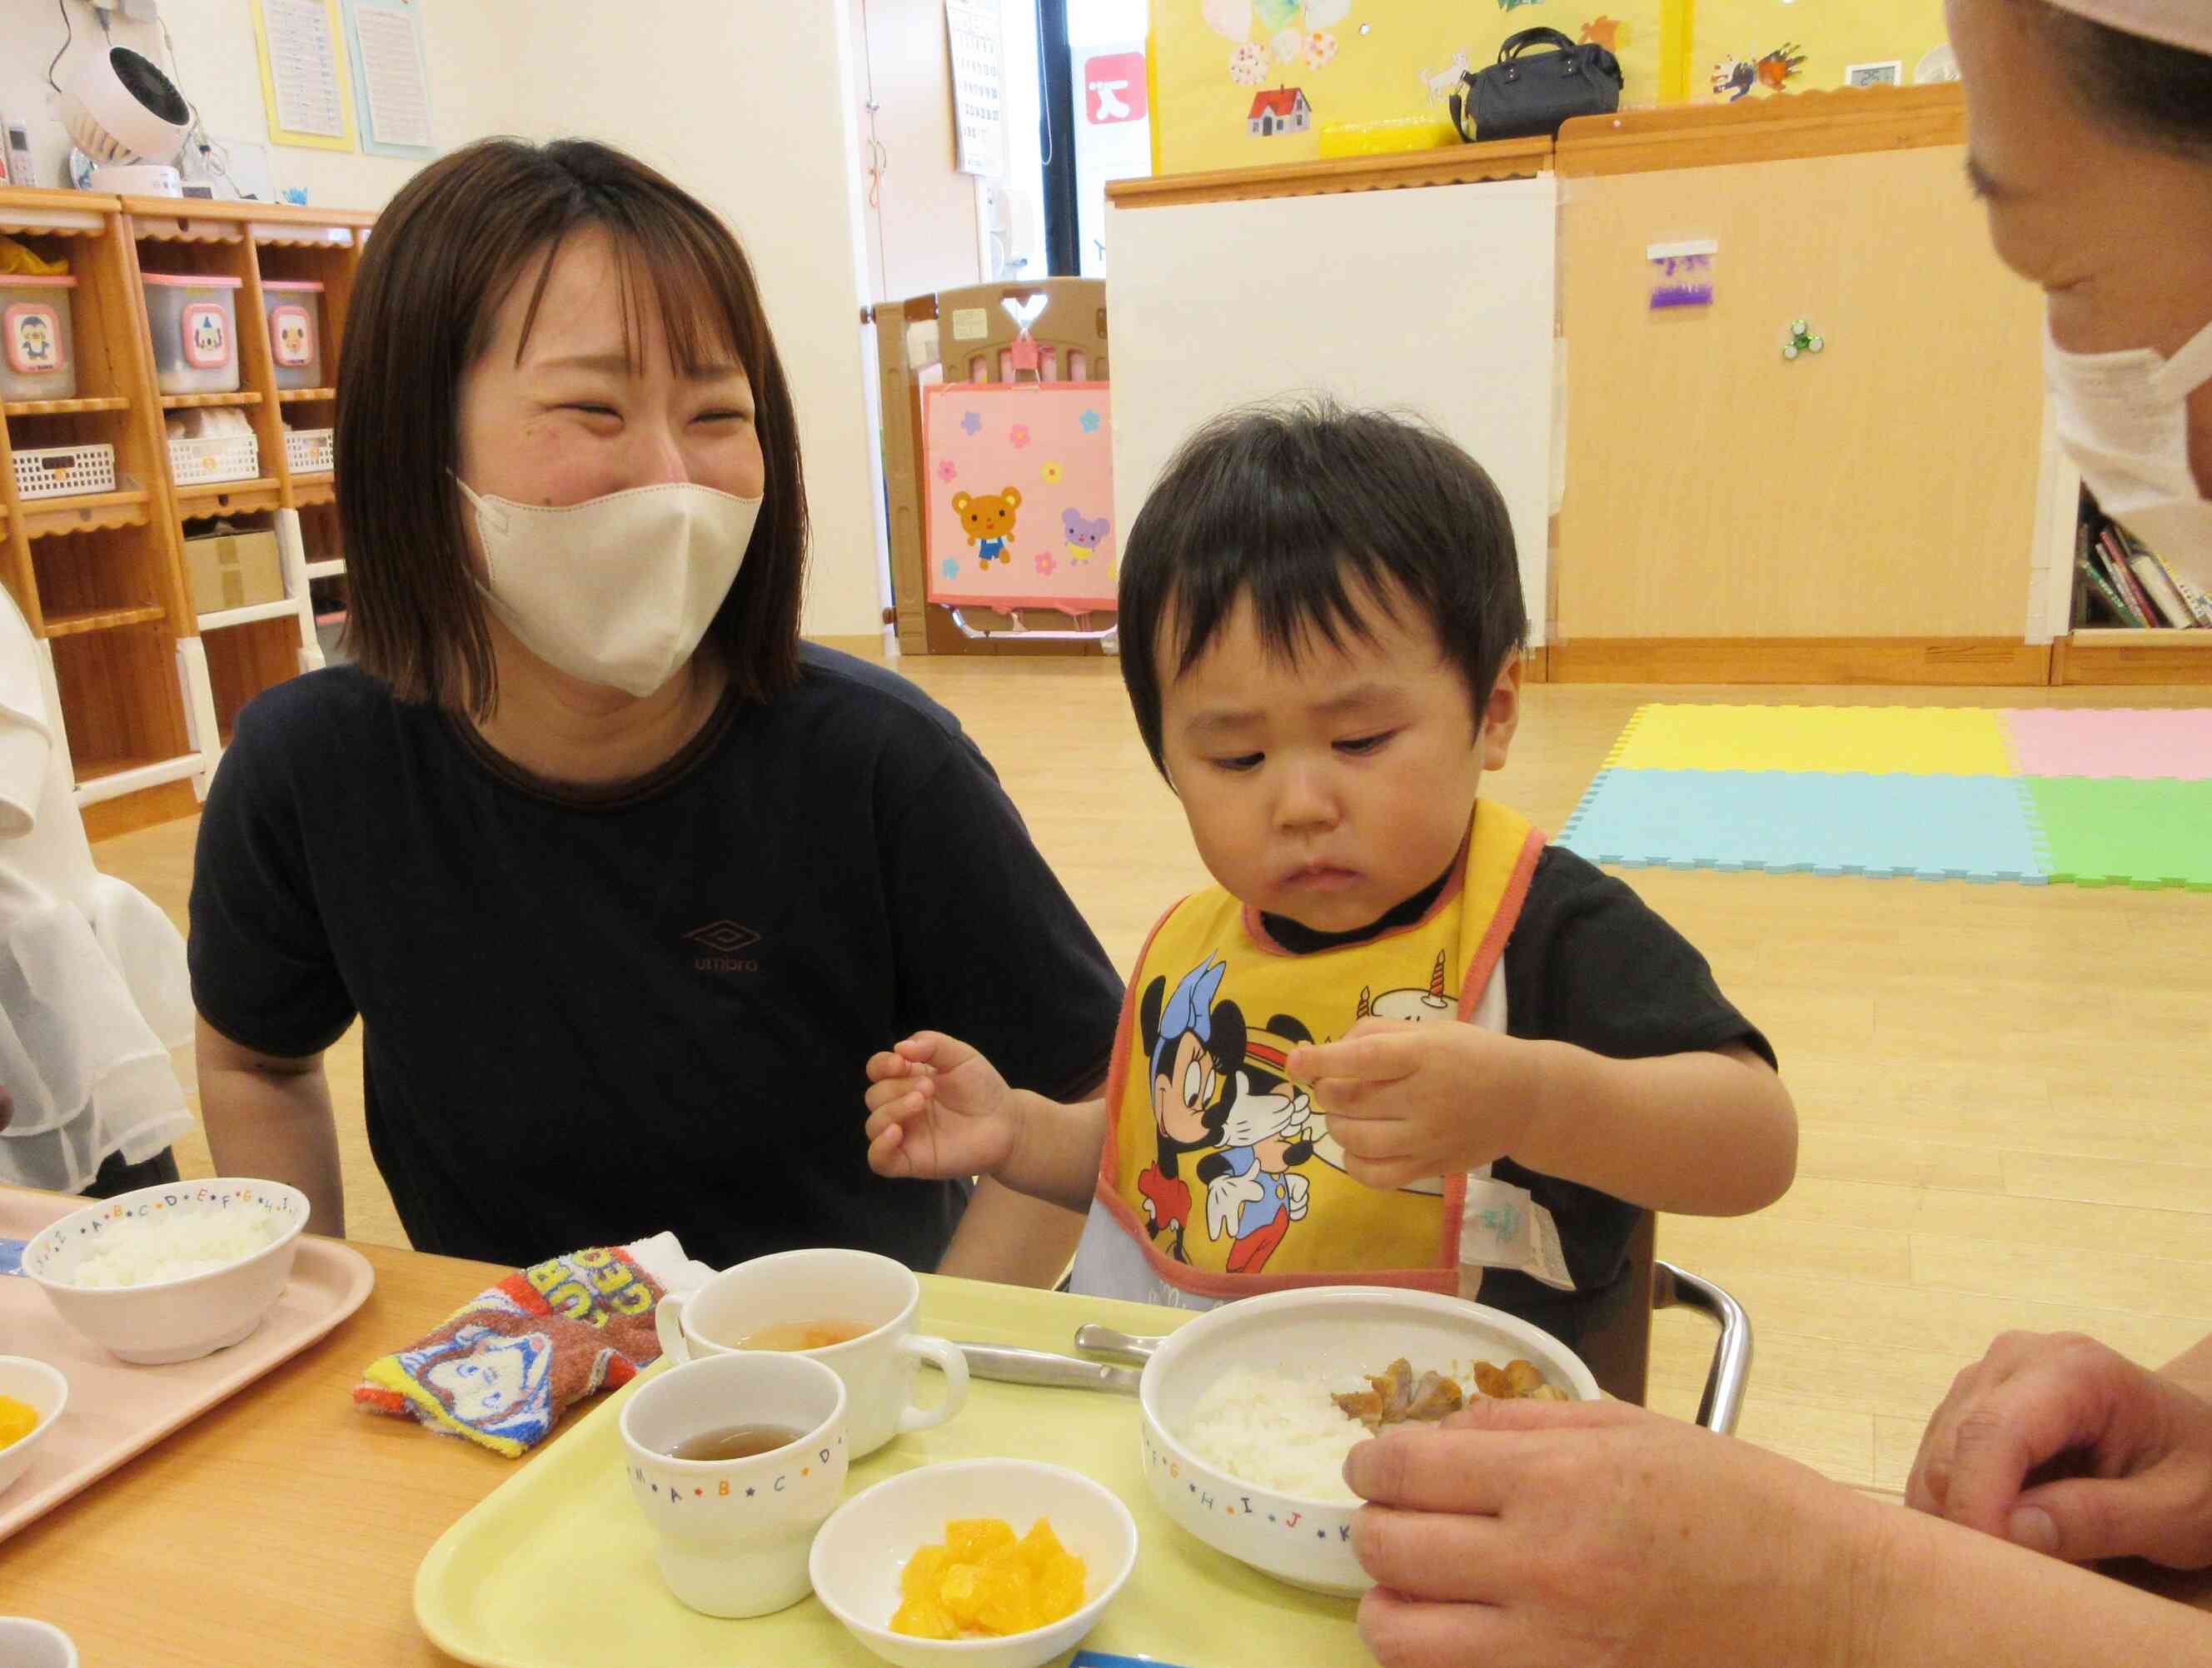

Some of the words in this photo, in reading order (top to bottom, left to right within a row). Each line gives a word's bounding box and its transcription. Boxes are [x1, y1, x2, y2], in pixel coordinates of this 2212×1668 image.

[694, 957, 760, 973] umbro
[138, 1204, 148, 1216] C
[164, 1195, 177, 1207] D
[197, 1188, 209, 1201] E
[222, 1195, 231, 1209] F
[670, 1487, 683, 1503] A
[719, 1479, 732, 1496] B
[774, 1475, 786, 1492] C
[820, 1448, 831, 1464] D
[1240, 1497, 1253, 1514] I
[1286, 1511, 1302, 1528] J
[1339, 1525, 1351, 1542] K
